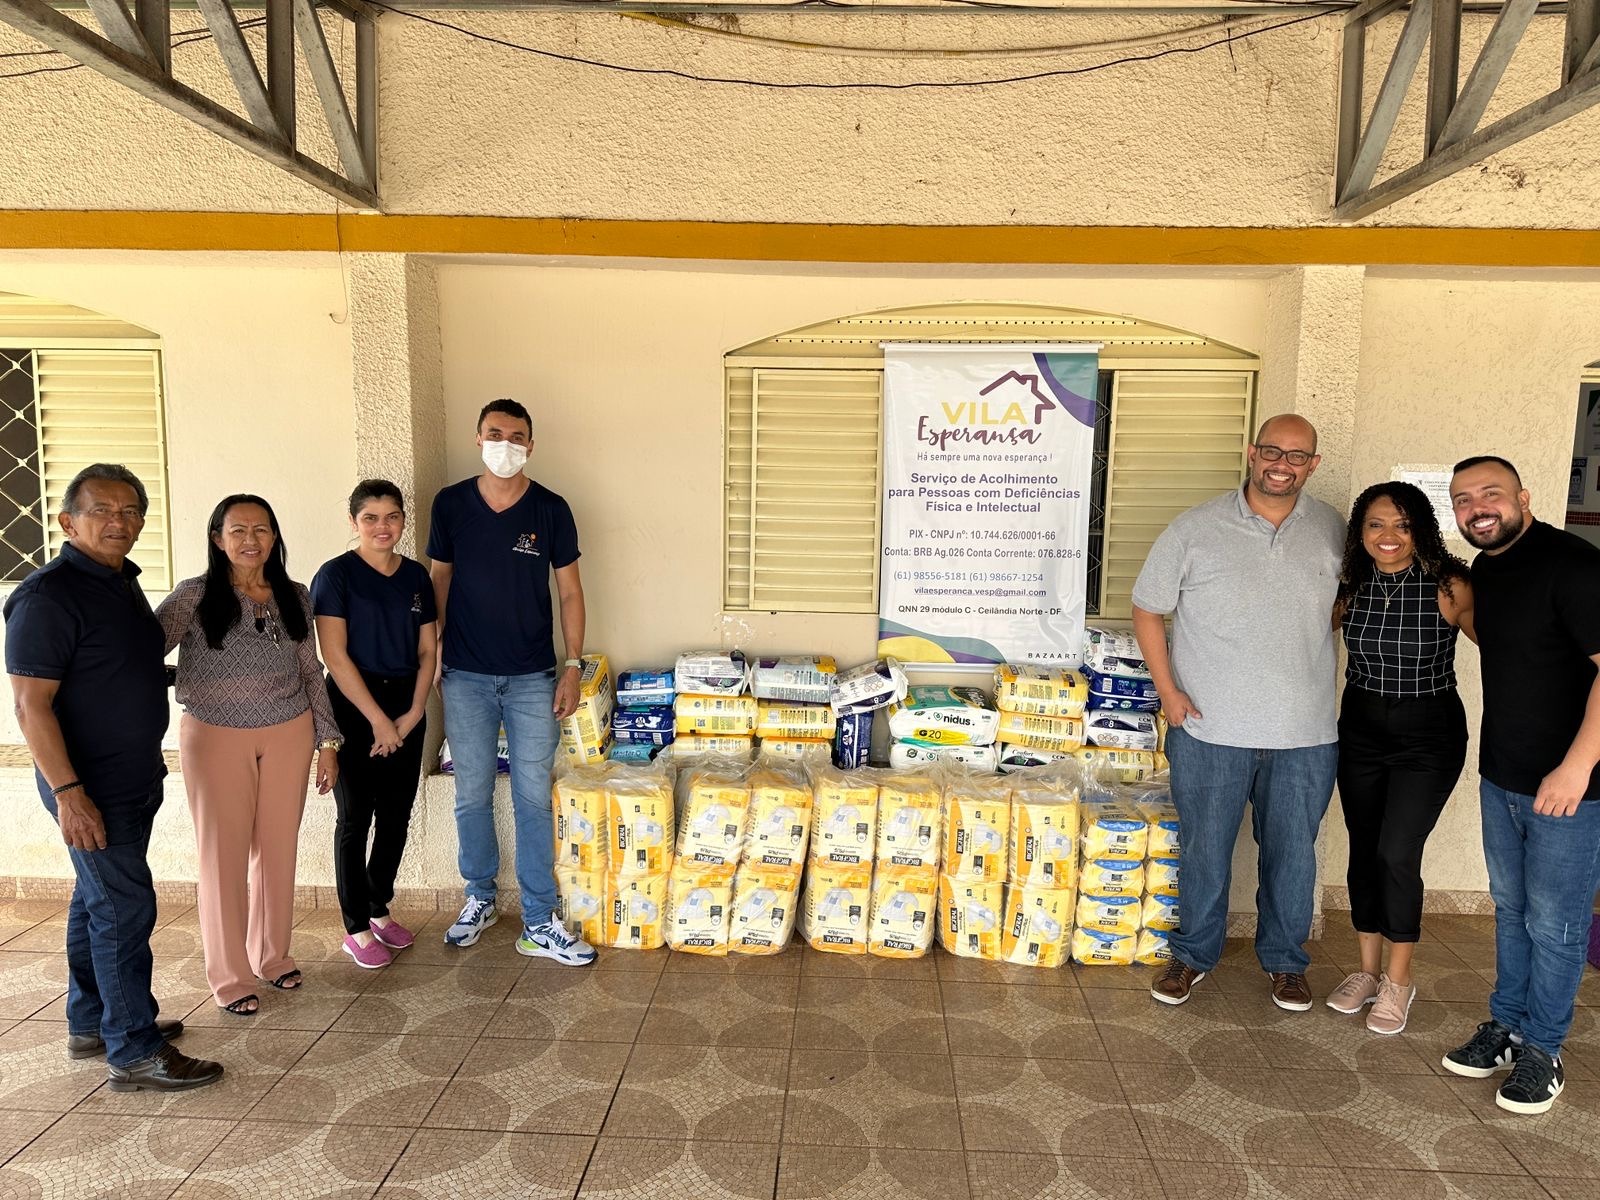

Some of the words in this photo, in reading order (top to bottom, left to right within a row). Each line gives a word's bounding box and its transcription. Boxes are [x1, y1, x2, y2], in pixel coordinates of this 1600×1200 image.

[941, 402, 1028, 425] VILA
[917, 452, 928, 461] Há
[930, 454, 960, 463] sempre
[1004, 454, 1048, 464] esperança
[911, 473, 957, 486] Serviço
[961, 474, 976, 484] de
[979, 474, 1058, 485] Acolhimento
[888, 489, 914, 500] para
[918, 488, 970, 498] Pessoas
[974, 490, 1001, 498] com
[1004, 487, 1080, 499] Deficiências
[926, 501, 962, 512] Física
[966, 504, 973, 512] e
[976, 502, 1041, 512] Intelectual
[910, 530, 924, 538] PIX
[930, 530, 954, 539] CNPJ
[970, 530, 1056, 540] 10.744.626/0001-66
[884, 547, 912, 557] Conta:
[914, 547, 932, 557] BRB
[934, 548, 964, 558] Ag.026
[966, 548, 992, 558] Conta
[994, 548, 1036, 559] Corrente:
[1038, 548, 1082, 559] 076.828-6
[894, 571, 912, 581] (61)
[914, 572, 966, 581] 98556-5181
[970, 572, 987, 583] (61)
[990, 573, 1044, 582] 98667-1254
[898, 604, 918, 614] QNN
[932, 605, 962, 614] módulo
[978, 606, 1018, 615] Ceilândia
[1020, 608, 1044, 616] Norte
[944, 714, 971, 726] nidus
